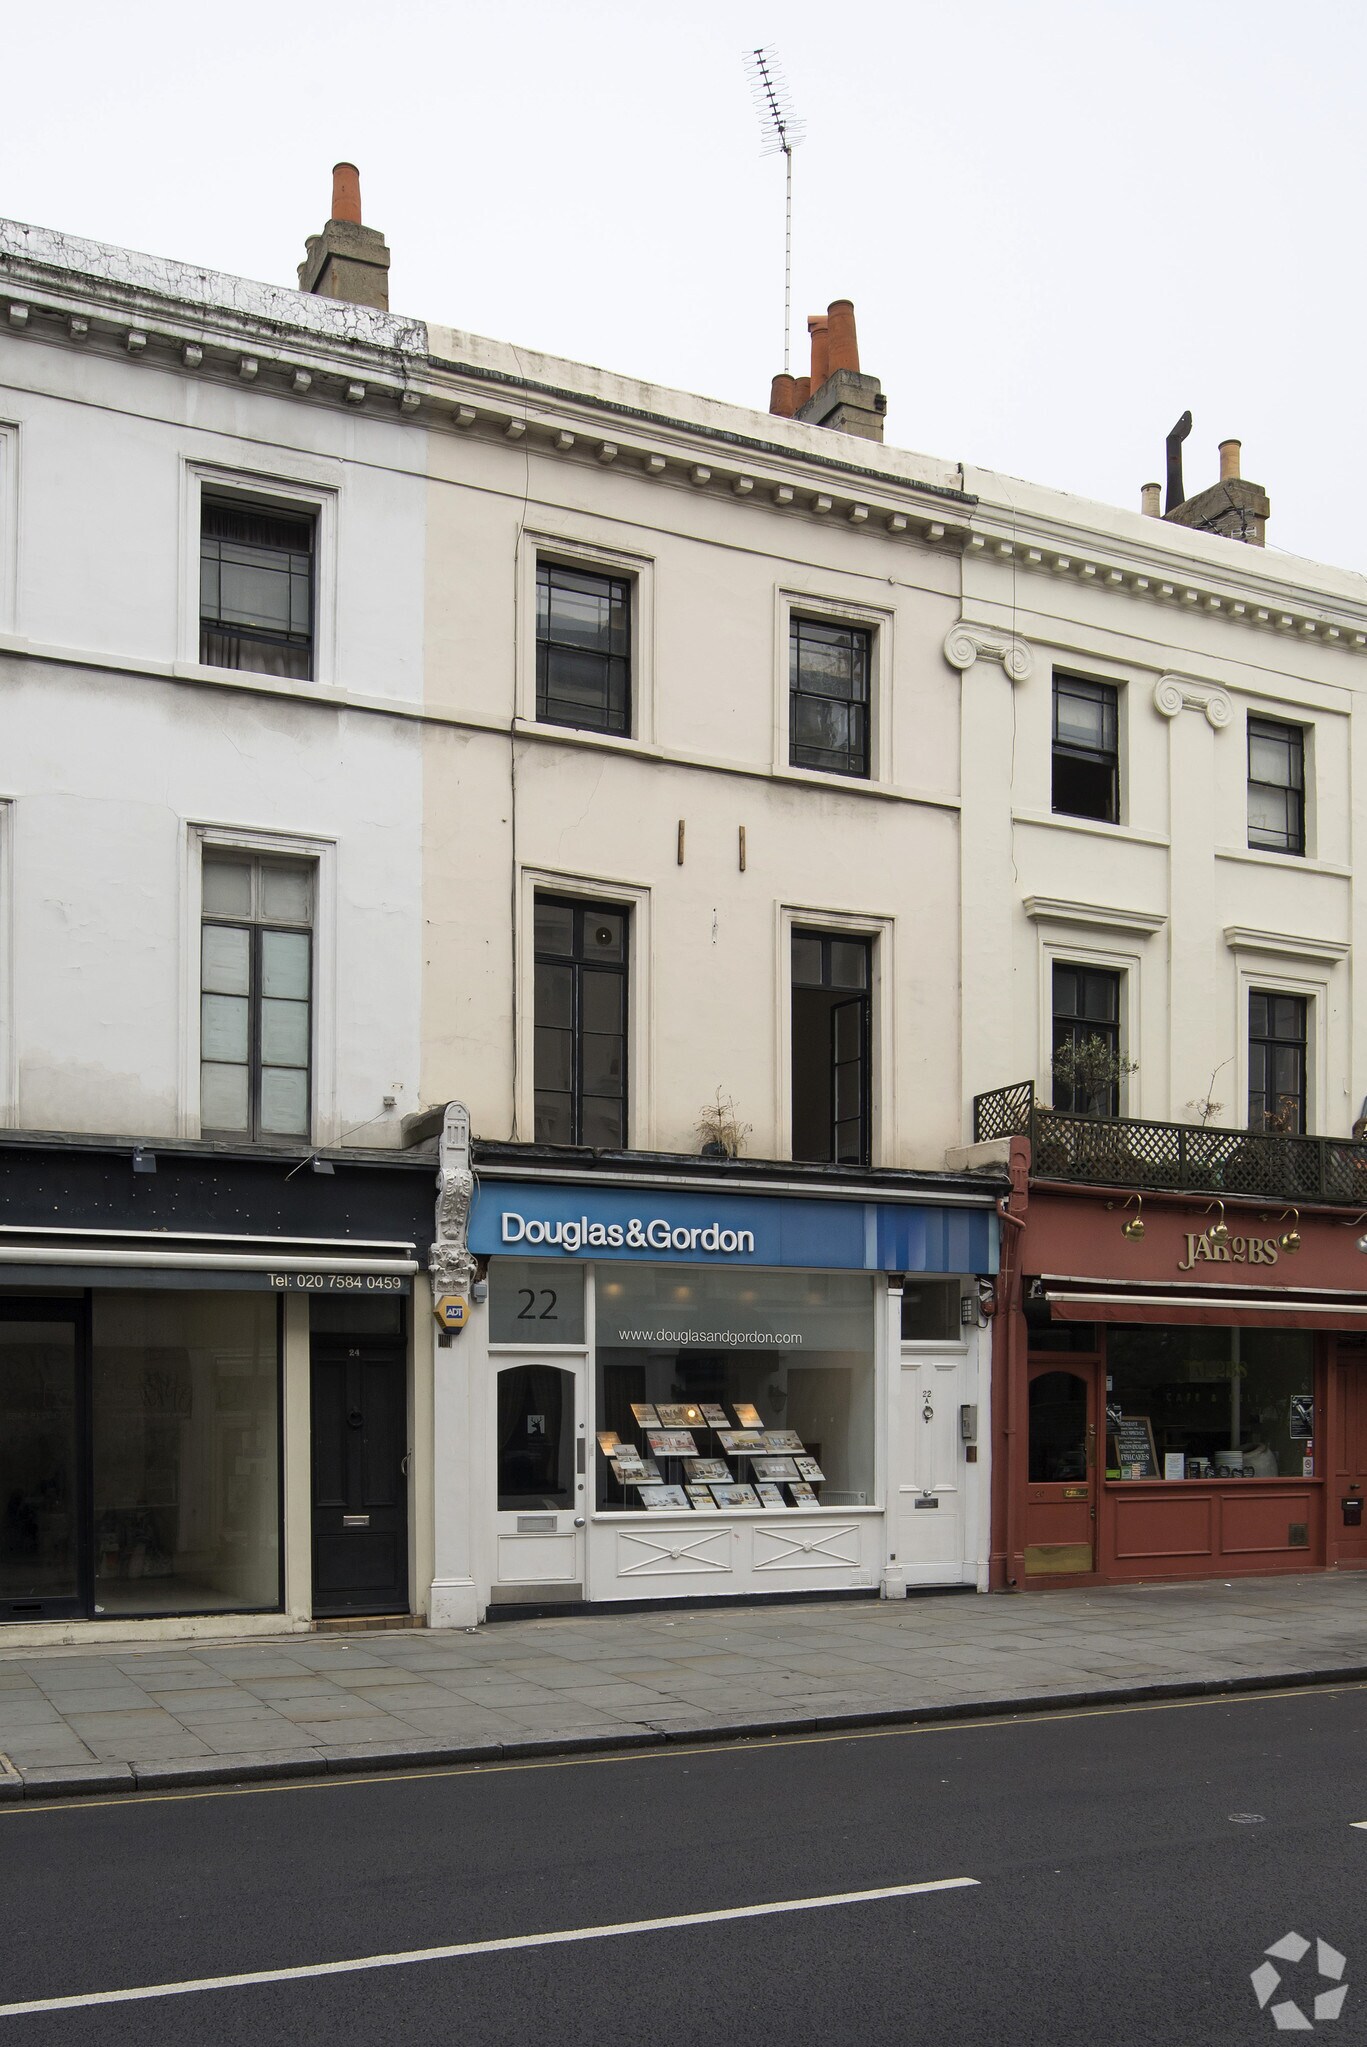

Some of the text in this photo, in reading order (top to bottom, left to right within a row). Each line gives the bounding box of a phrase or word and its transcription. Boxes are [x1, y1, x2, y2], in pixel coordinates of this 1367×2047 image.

[501, 1212, 755, 1252] Douglas&Gordon
[267, 1273, 401, 1289] Tel: 020 7584 0459
[446, 1307, 463, 1317] ADT
[517, 1288, 558, 1320] 22
[618, 1328, 802, 1346] www.douglasandgordon.com
[348, 1348, 360, 1357] 24
[922, 1390, 932, 1398] 22
